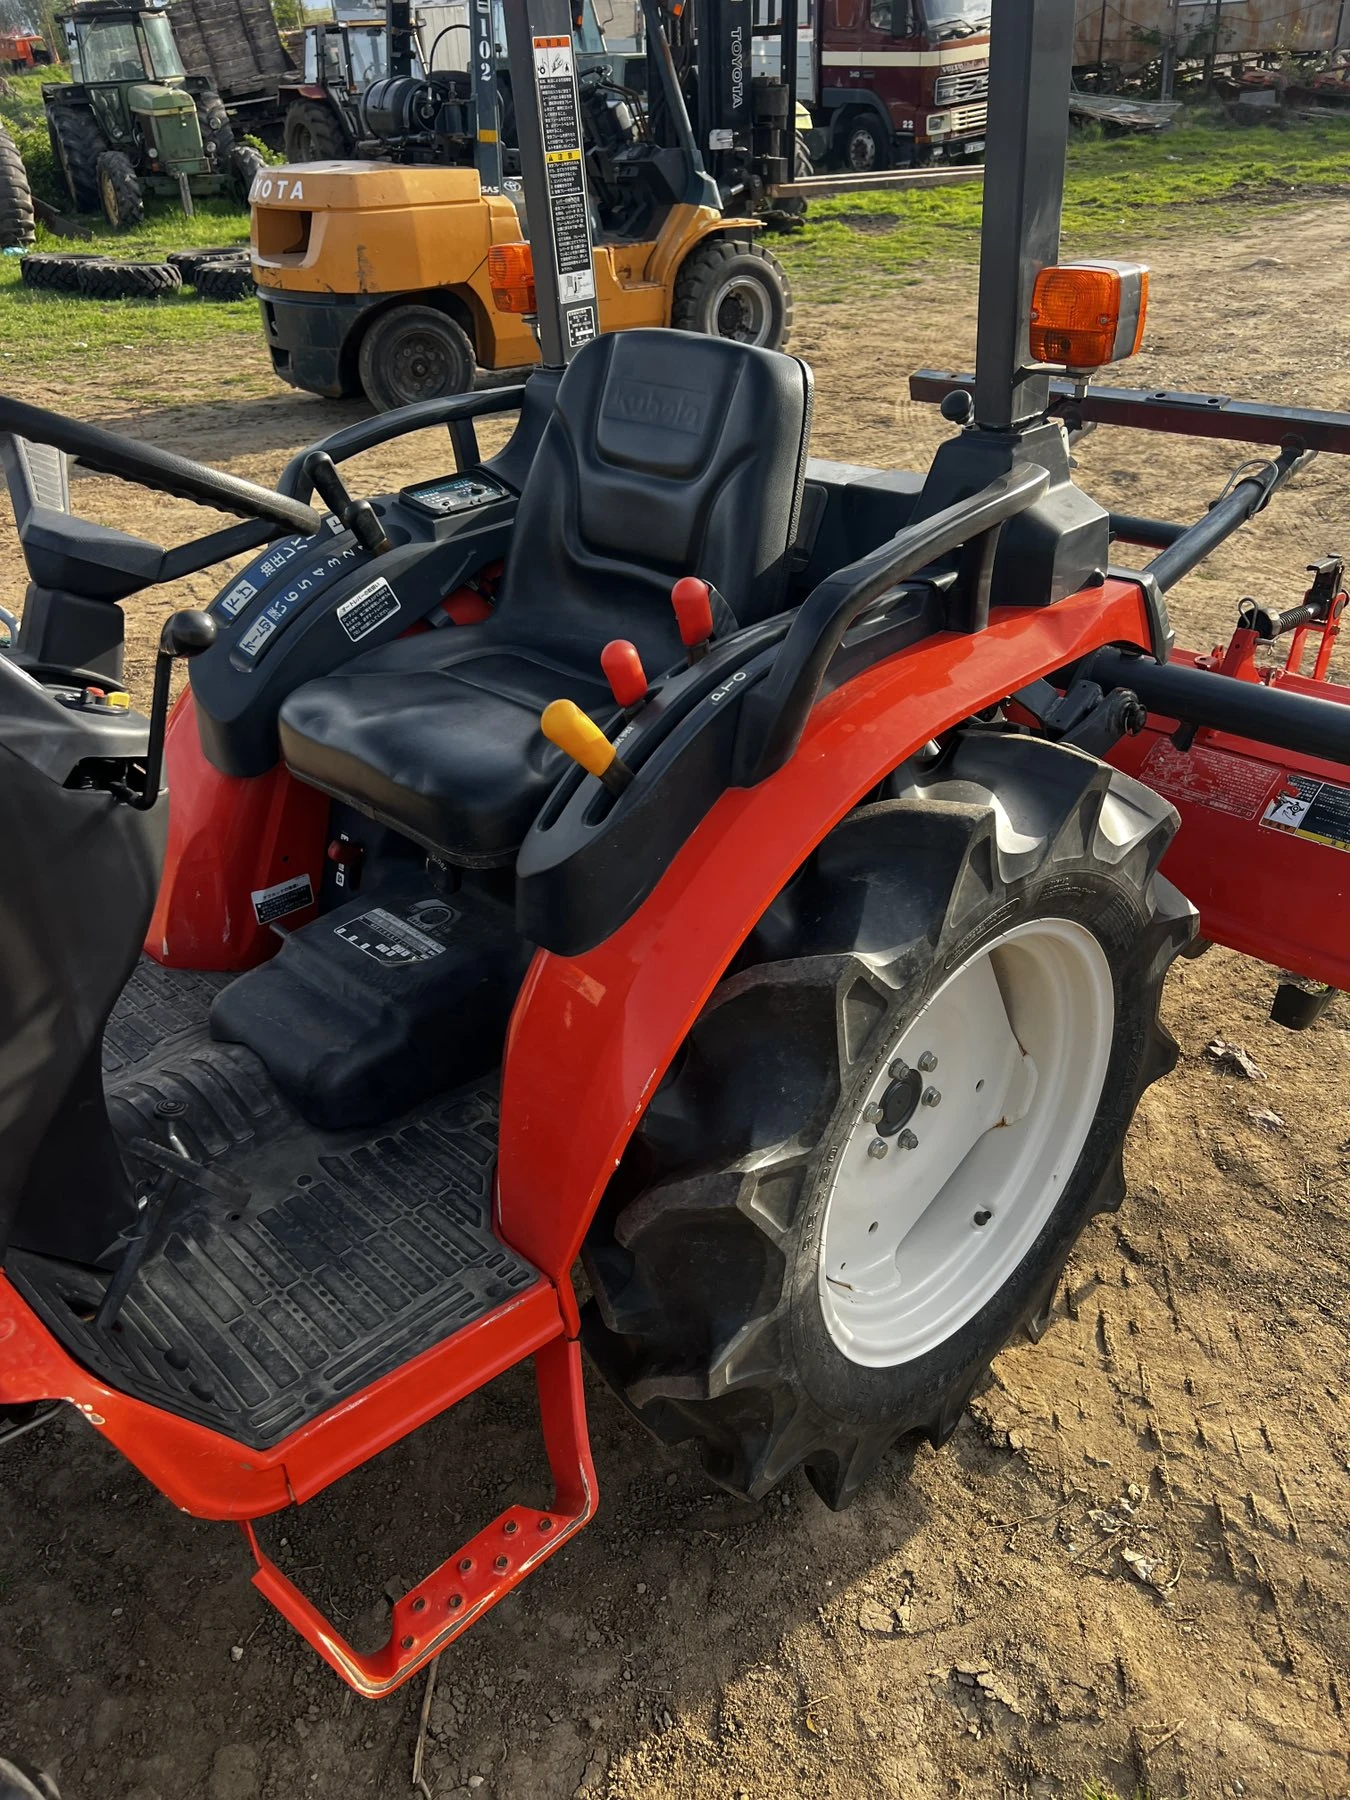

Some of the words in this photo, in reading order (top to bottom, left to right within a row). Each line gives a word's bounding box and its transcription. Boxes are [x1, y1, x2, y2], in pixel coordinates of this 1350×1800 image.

[479, 18, 491, 81] 102
[731, 26, 744, 109] TOYOTA
[902, 120, 914, 129] 22
[284, 591, 299, 602] 6
[297, 579, 312, 590] 5
[312, 567, 325, 576] 4
[327, 557, 341, 568] 3
[342, 548, 355, 559] 2
[711, 672, 747, 702] PTO
